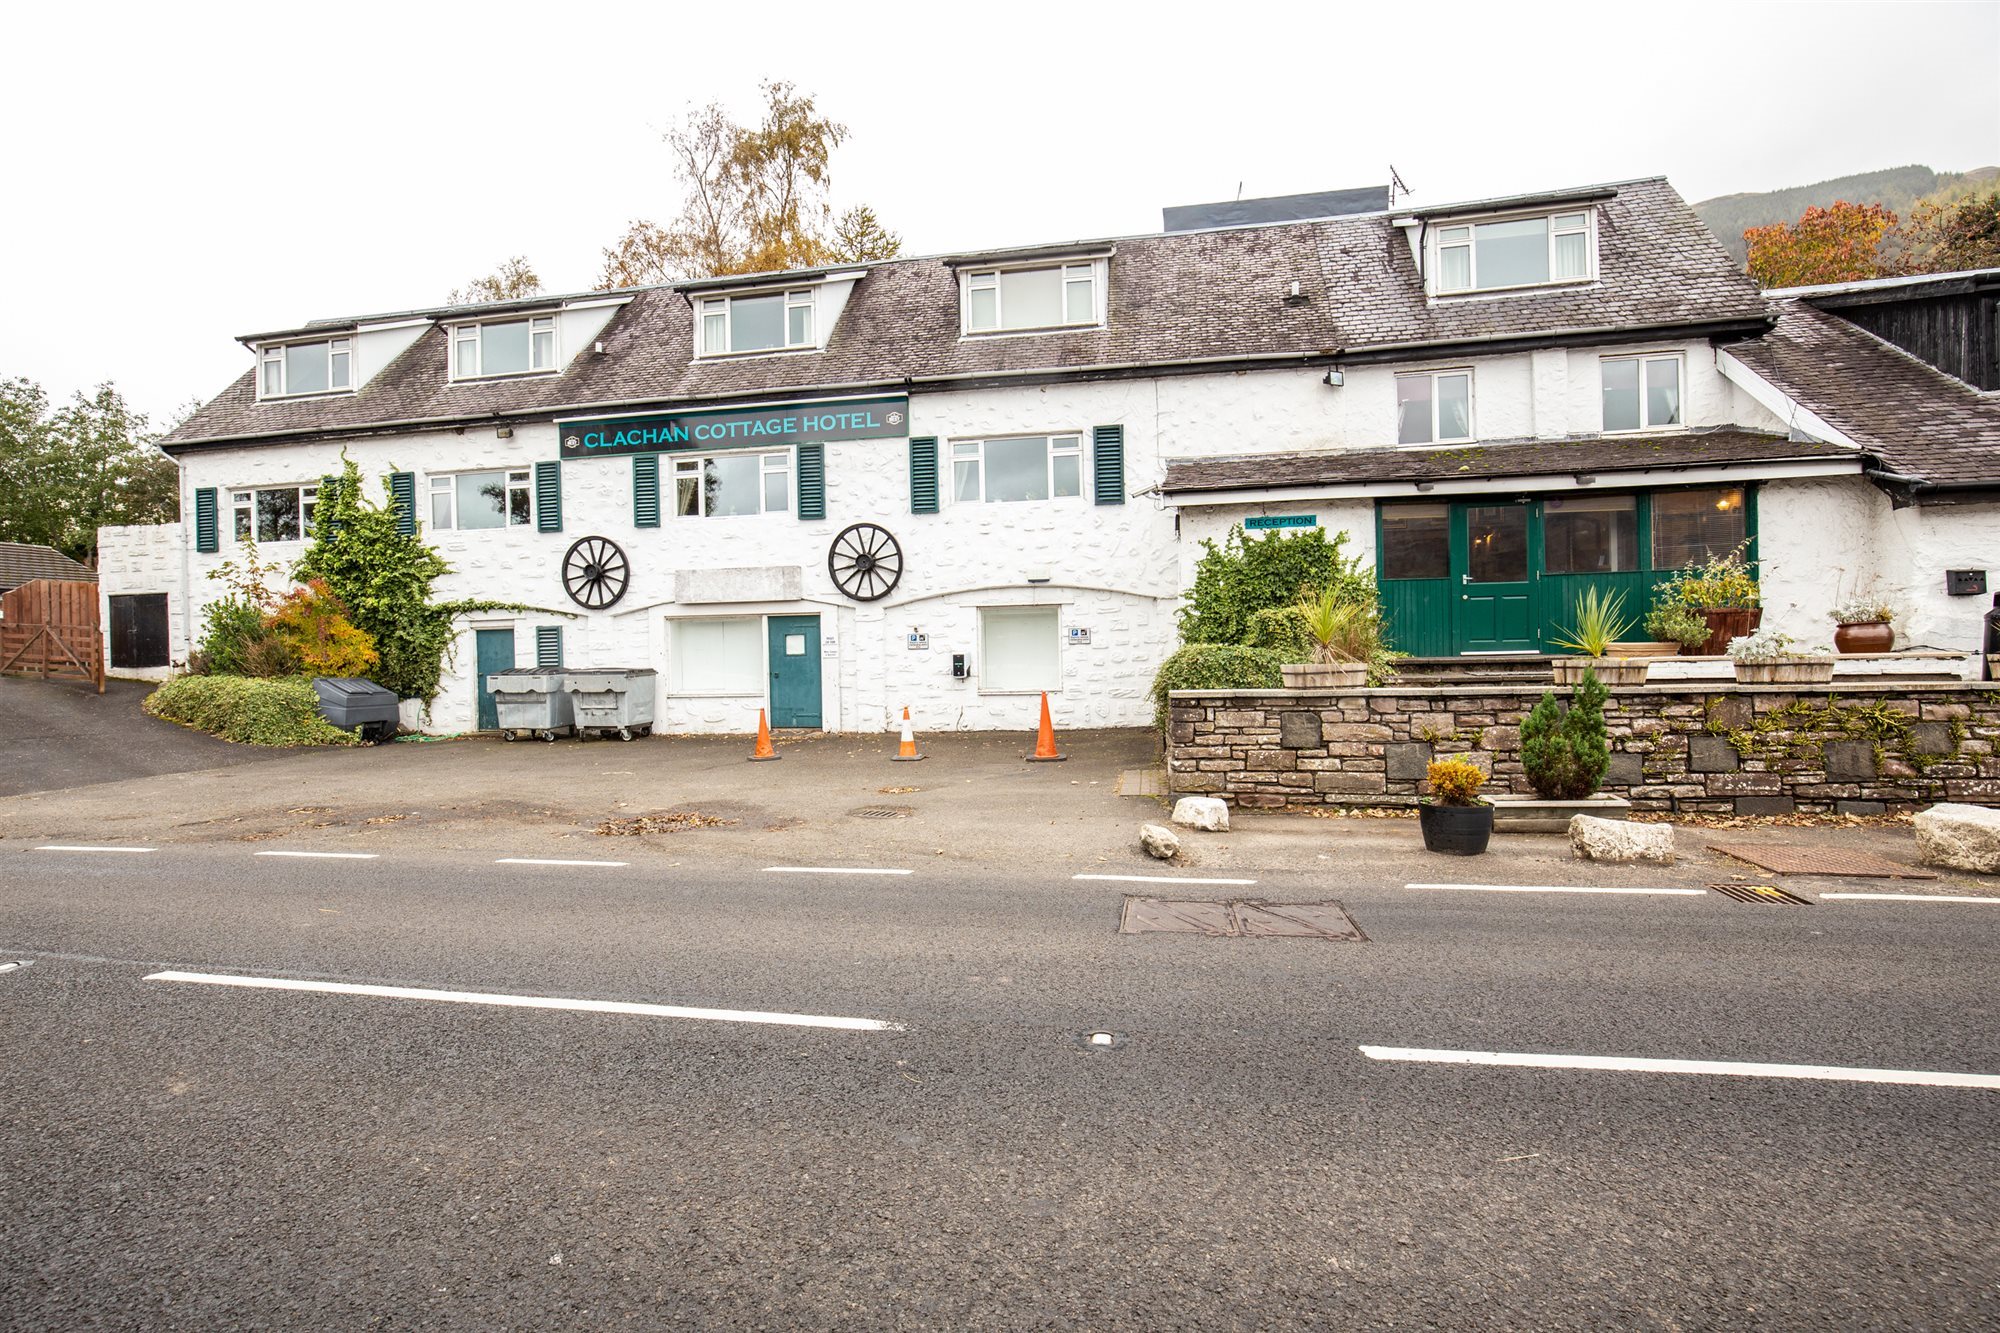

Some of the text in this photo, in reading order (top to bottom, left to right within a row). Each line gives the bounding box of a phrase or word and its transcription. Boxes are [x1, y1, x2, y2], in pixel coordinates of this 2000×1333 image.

[584, 411, 881, 449] CLACHAN COTTAGE HOTEL
[1249, 517, 1312, 527] RECEPTION
